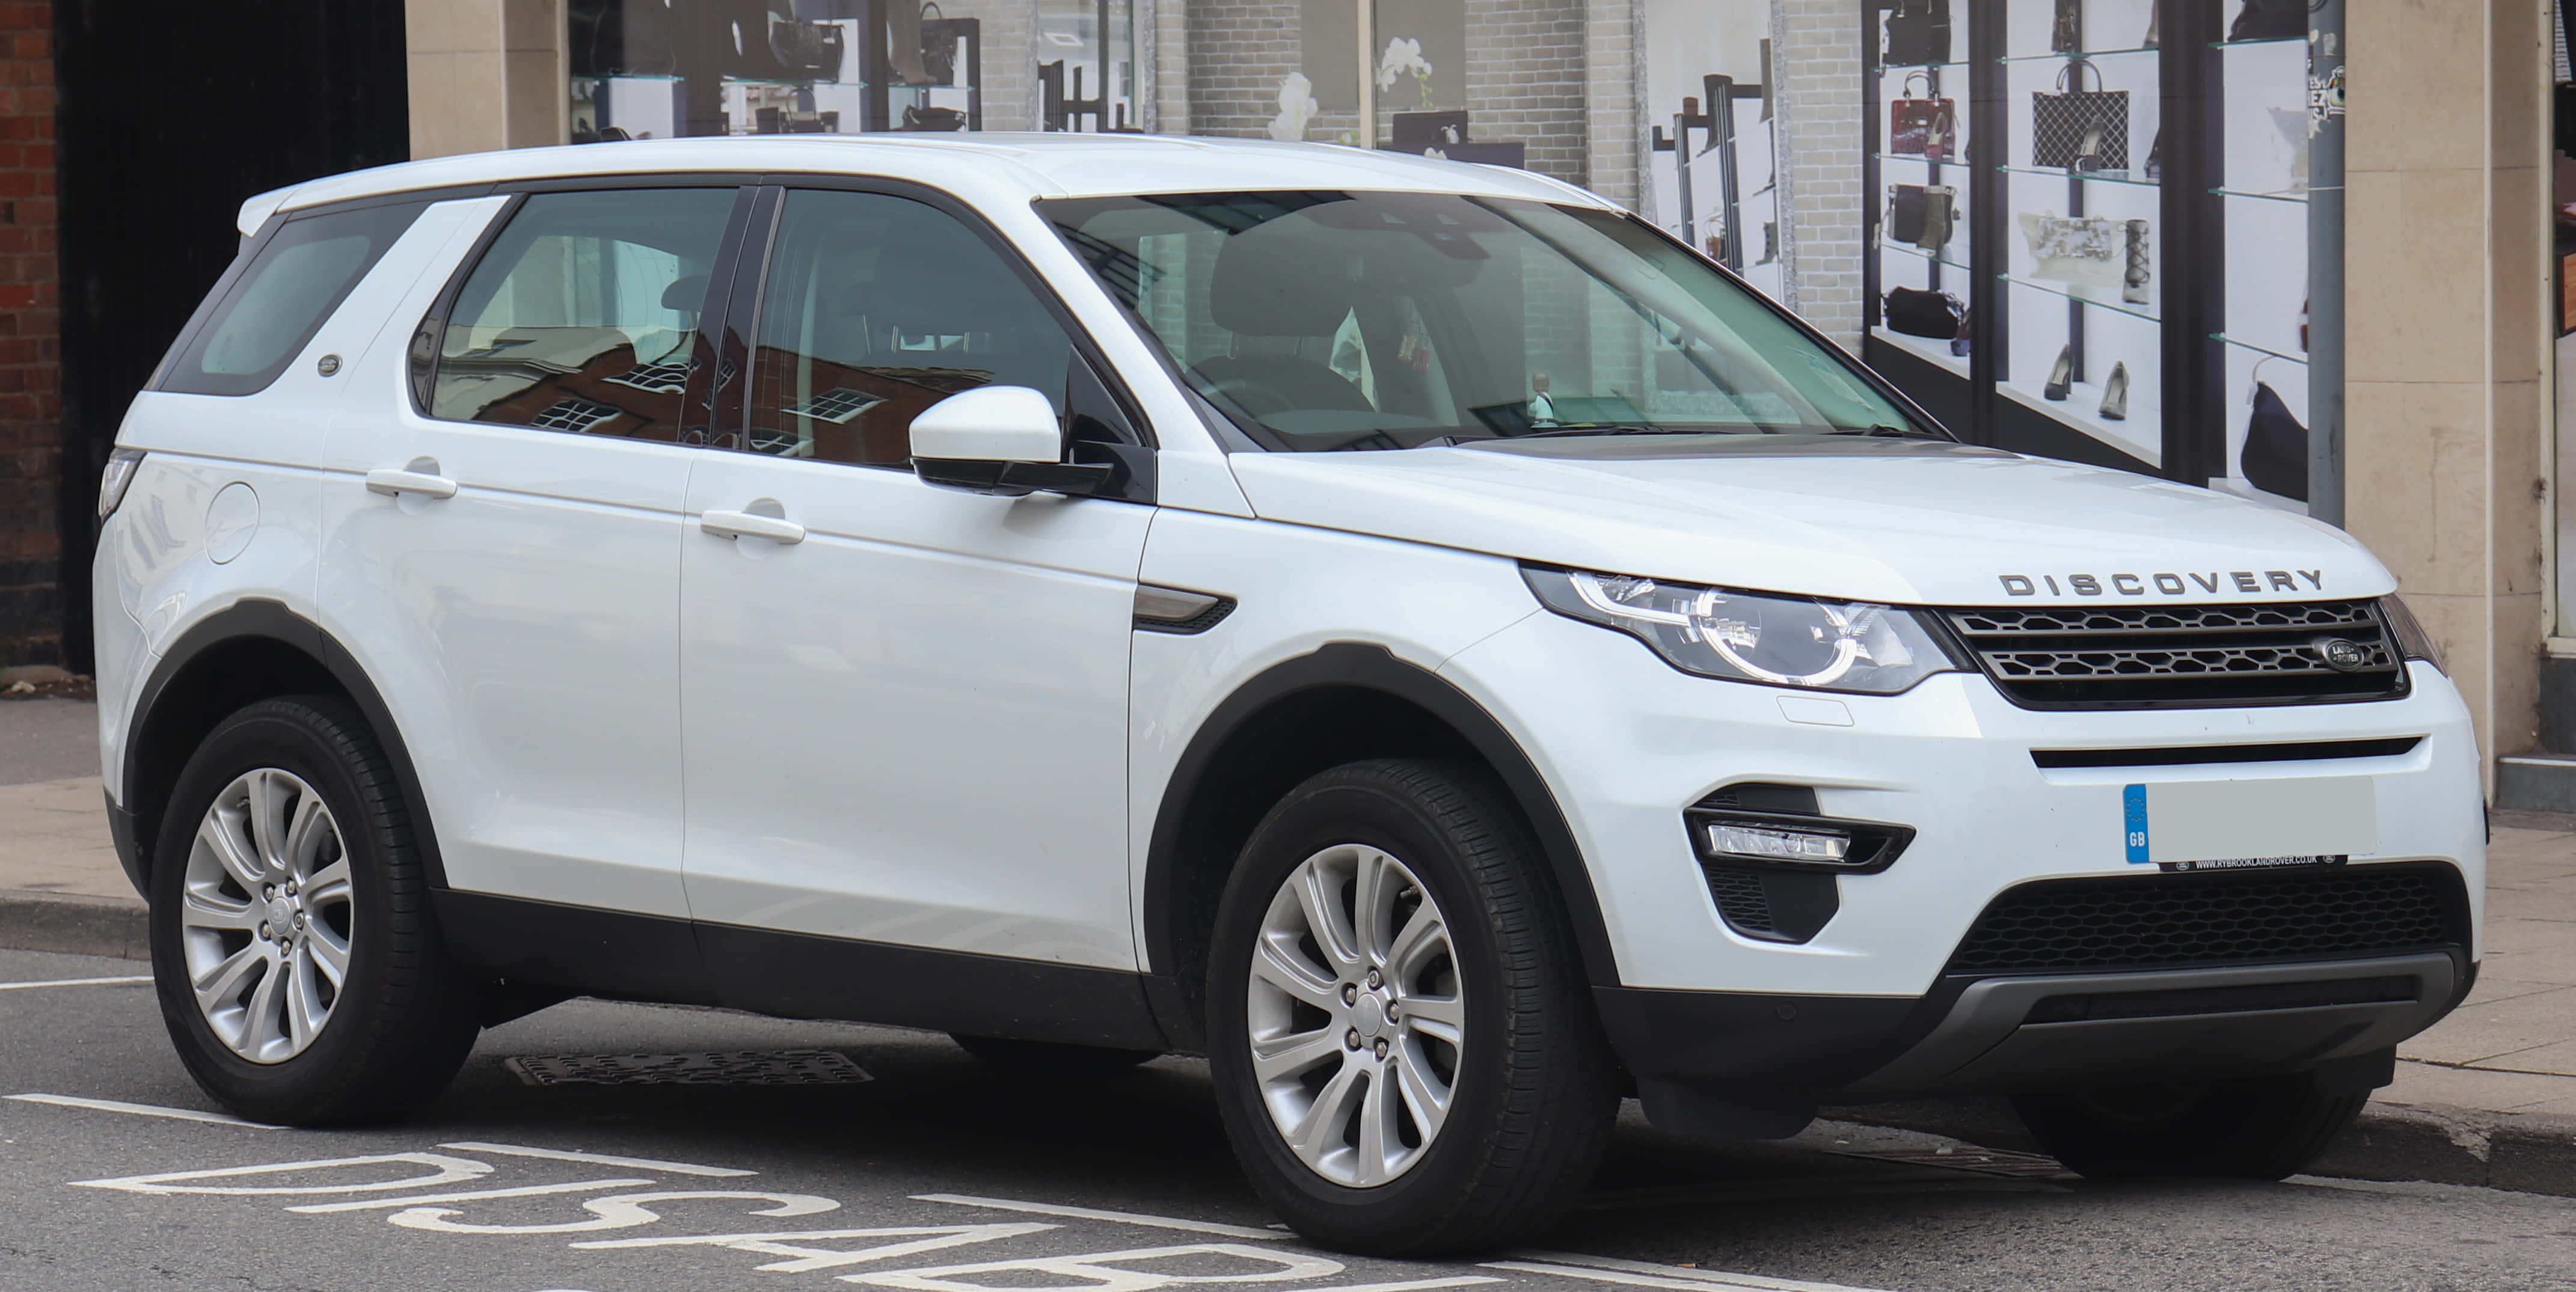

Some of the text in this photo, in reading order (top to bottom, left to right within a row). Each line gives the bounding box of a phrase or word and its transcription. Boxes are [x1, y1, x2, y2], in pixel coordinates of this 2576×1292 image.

[1998, 569, 2322, 596] DISCOVERY
[2129, 831, 2145, 847] GB
[2196, 856, 2317, 869] WWW.RYBROOKLANDROVER.CO.UK
